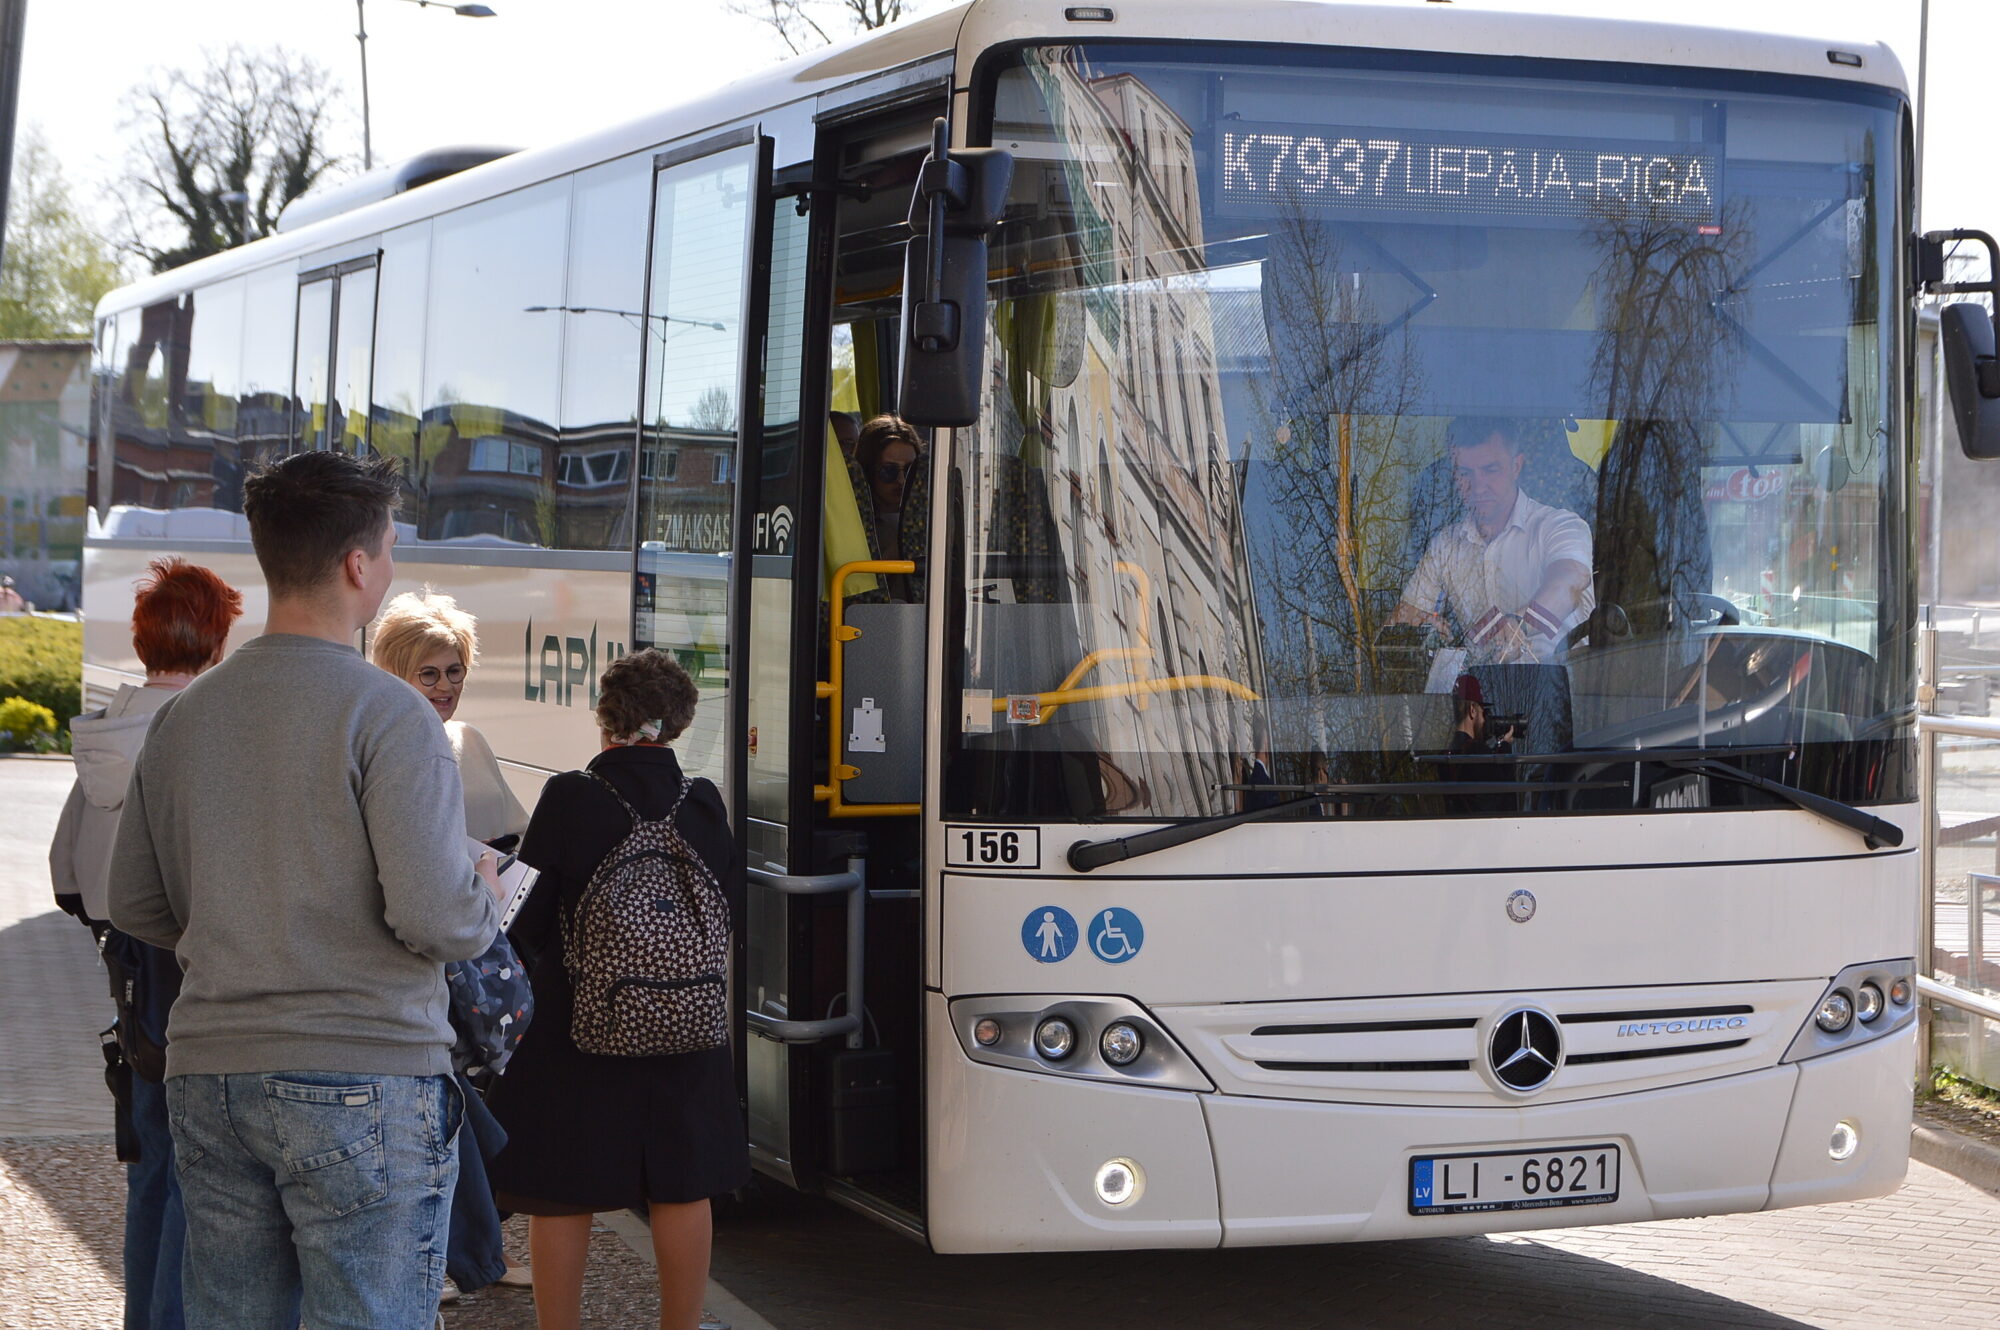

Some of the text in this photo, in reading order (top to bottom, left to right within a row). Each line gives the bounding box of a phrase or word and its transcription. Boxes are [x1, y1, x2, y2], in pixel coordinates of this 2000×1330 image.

[1223, 132, 1401, 197] K7937
[961, 831, 1019, 864] 156
[1616, 1016, 1750, 1038] INTOURO
[1415, 1187, 1430, 1199] LV
[1443, 1162, 1479, 1200] LI
